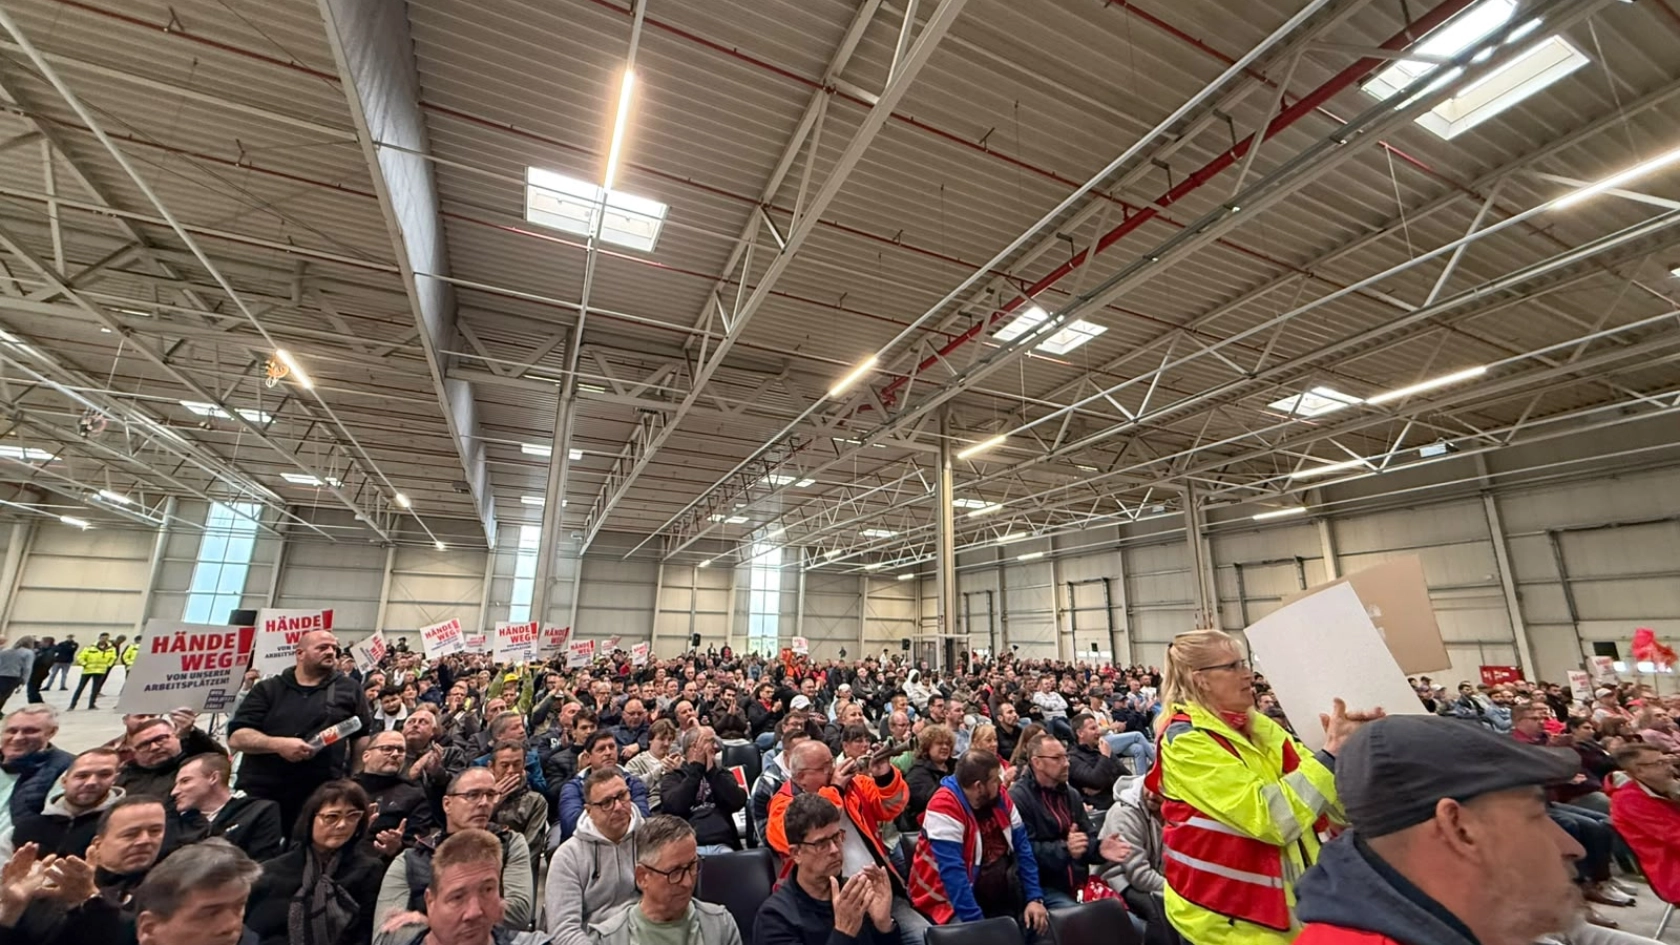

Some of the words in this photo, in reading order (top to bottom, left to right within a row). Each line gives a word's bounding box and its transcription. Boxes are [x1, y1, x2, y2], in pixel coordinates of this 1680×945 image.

[166, 673, 187, 681] VON
[189, 669, 231, 680] UNSEREN
[144, 677, 229, 691] ARBEITSPLÄTZEN!
